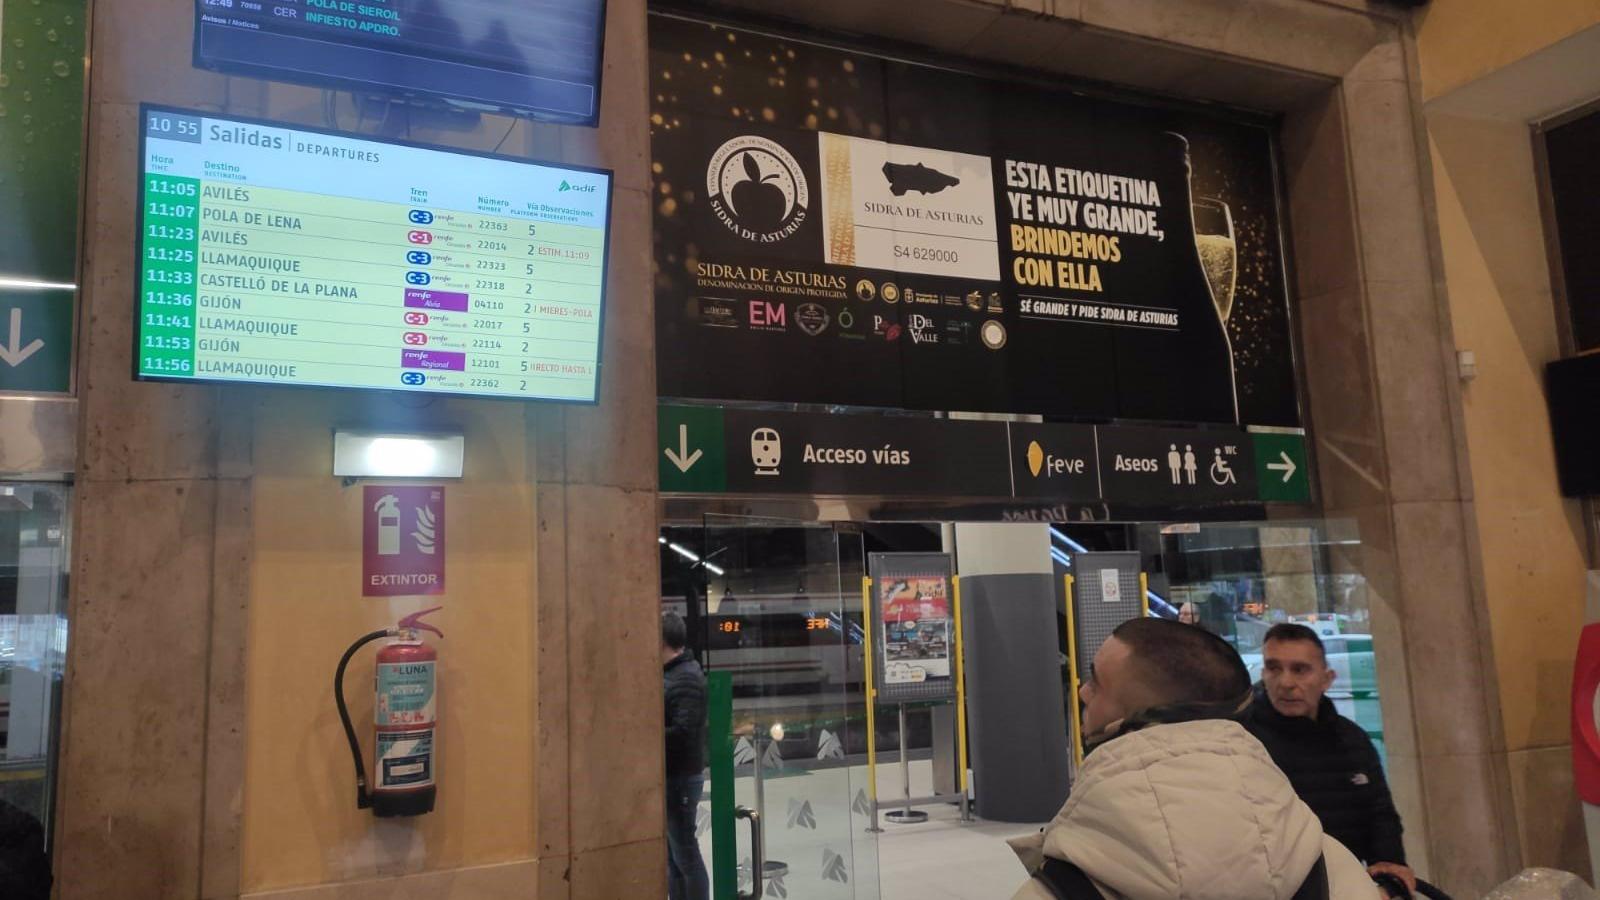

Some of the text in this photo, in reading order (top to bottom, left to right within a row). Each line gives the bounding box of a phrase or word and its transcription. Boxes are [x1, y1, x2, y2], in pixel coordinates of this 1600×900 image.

[273, 6, 297, 18] CER
[306, 12, 401, 37] INFIESTO APDRO.
[340, 2, 356, 13] DE
[358, 5, 400, 21] SIERO/L
[150, 117, 198, 136] 10 55
[210, 124, 381, 164] Salidas DEPARTURES
[151, 154, 174, 164] Hora
[204, 160, 240, 172] Destino
[410, 187, 428, 197] Tren
[1005, 159, 1162, 207] ESTA ETIQUETINA
[150, 180, 196, 196] 11:05
[202, 184, 250, 202] AVILÉS
[410, 211, 432, 224] C-3
[479, 220, 508, 232] 22363
[528, 224, 536, 236] 5
[478, 196, 509, 207] Número
[528, 202, 594, 217] Vía Observaciones
[864, 202, 984, 226] SIDRA DE ASTURIAS
[149, 202, 195, 218] 11:07
[202, 208, 238, 224] POLA
[244, 212, 262, 226] DE
[266, 214, 302, 230] LENA
[408, 232, 430, 244] C-1
[478, 240, 506, 252] 22014
[528, 244, 534, 256] 2
[710, 200, 806, 243] SIDRA DE ASTURIAS
[1006, 192, 1165, 242] YE MUY GRANDE,
[148, 224, 194, 241] 11:23
[201, 228, 248, 246] AVILÉS
[408, 252, 430, 264] C-3
[476, 260, 506, 271] 22323
[526, 264, 534, 275] 5
[894, 245, 959, 264] S4 629000
[1010, 224, 1122, 263] BRINDEMOS
[148, 246, 194, 263] 11:25
[201, 250, 301, 273] LLAMAQUIQUE
[406, 272, 429, 284] C-3
[476, 280, 505, 290] 22318
[526, 283, 532, 294] 2
[697, 263, 847, 290] SIDRA DE ASTURIAS
[1013, 256, 1104, 292] CON ELLA
[147, 268, 193, 285] 11:33
[200, 272, 266, 290] CASTELLÓ
[271, 279, 289, 292] DE
[294, 281, 310, 294] LA
[314, 283, 358, 300] PLANA
[407, 291, 432, 300] renfe
[474, 299, 504, 310] 04110
[524, 302, 531, 314] 2
[764, 284, 775, 292] DE
[776, 286, 806, 296] ORIGEN
[806, 288, 848, 299] PROTEGIDA
[146, 291, 192, 307] 11:36
[199, 295, 242, 310] GIJÓN
[404, 312, 428, 324] C-1
[474, 319, 503, 330] 22017
[523, 322, 530, 333] 5
[750, 300, 786, 326] EM
[1020, 298, 1179, 326] SÉ GRANDE Y PIDE SIDRA DE ASTURIAS
[146, 313, 192, 329] 11:41
[199, 316, 299, 336] LLAMAQUIQUE
[404, 332, 426, 344] C-1
[472, 338, 502, 350] 22114
[522, 342, 529, 352] 2
[145, 335, 191, 350] 11:53
[198, 338, 240, 353] GIJÓN
[404, 352, 429, 360] renfe
[472, 358, 500, 369] 12101
[521, 360, 528, 372] 5
[144, 356, 190, 372] 11:56
[198, 358, 297, 378] LLAMAQUIQUE
[402, 373, 424, 385] C-3
[470, 378, 500, 388] 22362
[520, 380, 526, 392] 2
[803, 444, 911, 465] Acceso vías
[1046, 454, 1084, 478] feve
[1114, 446, 1238, 472] Aseos WC
[370, 574, 438, 586] EXTINTOR
[400, 666, 427, 675] LUNA
